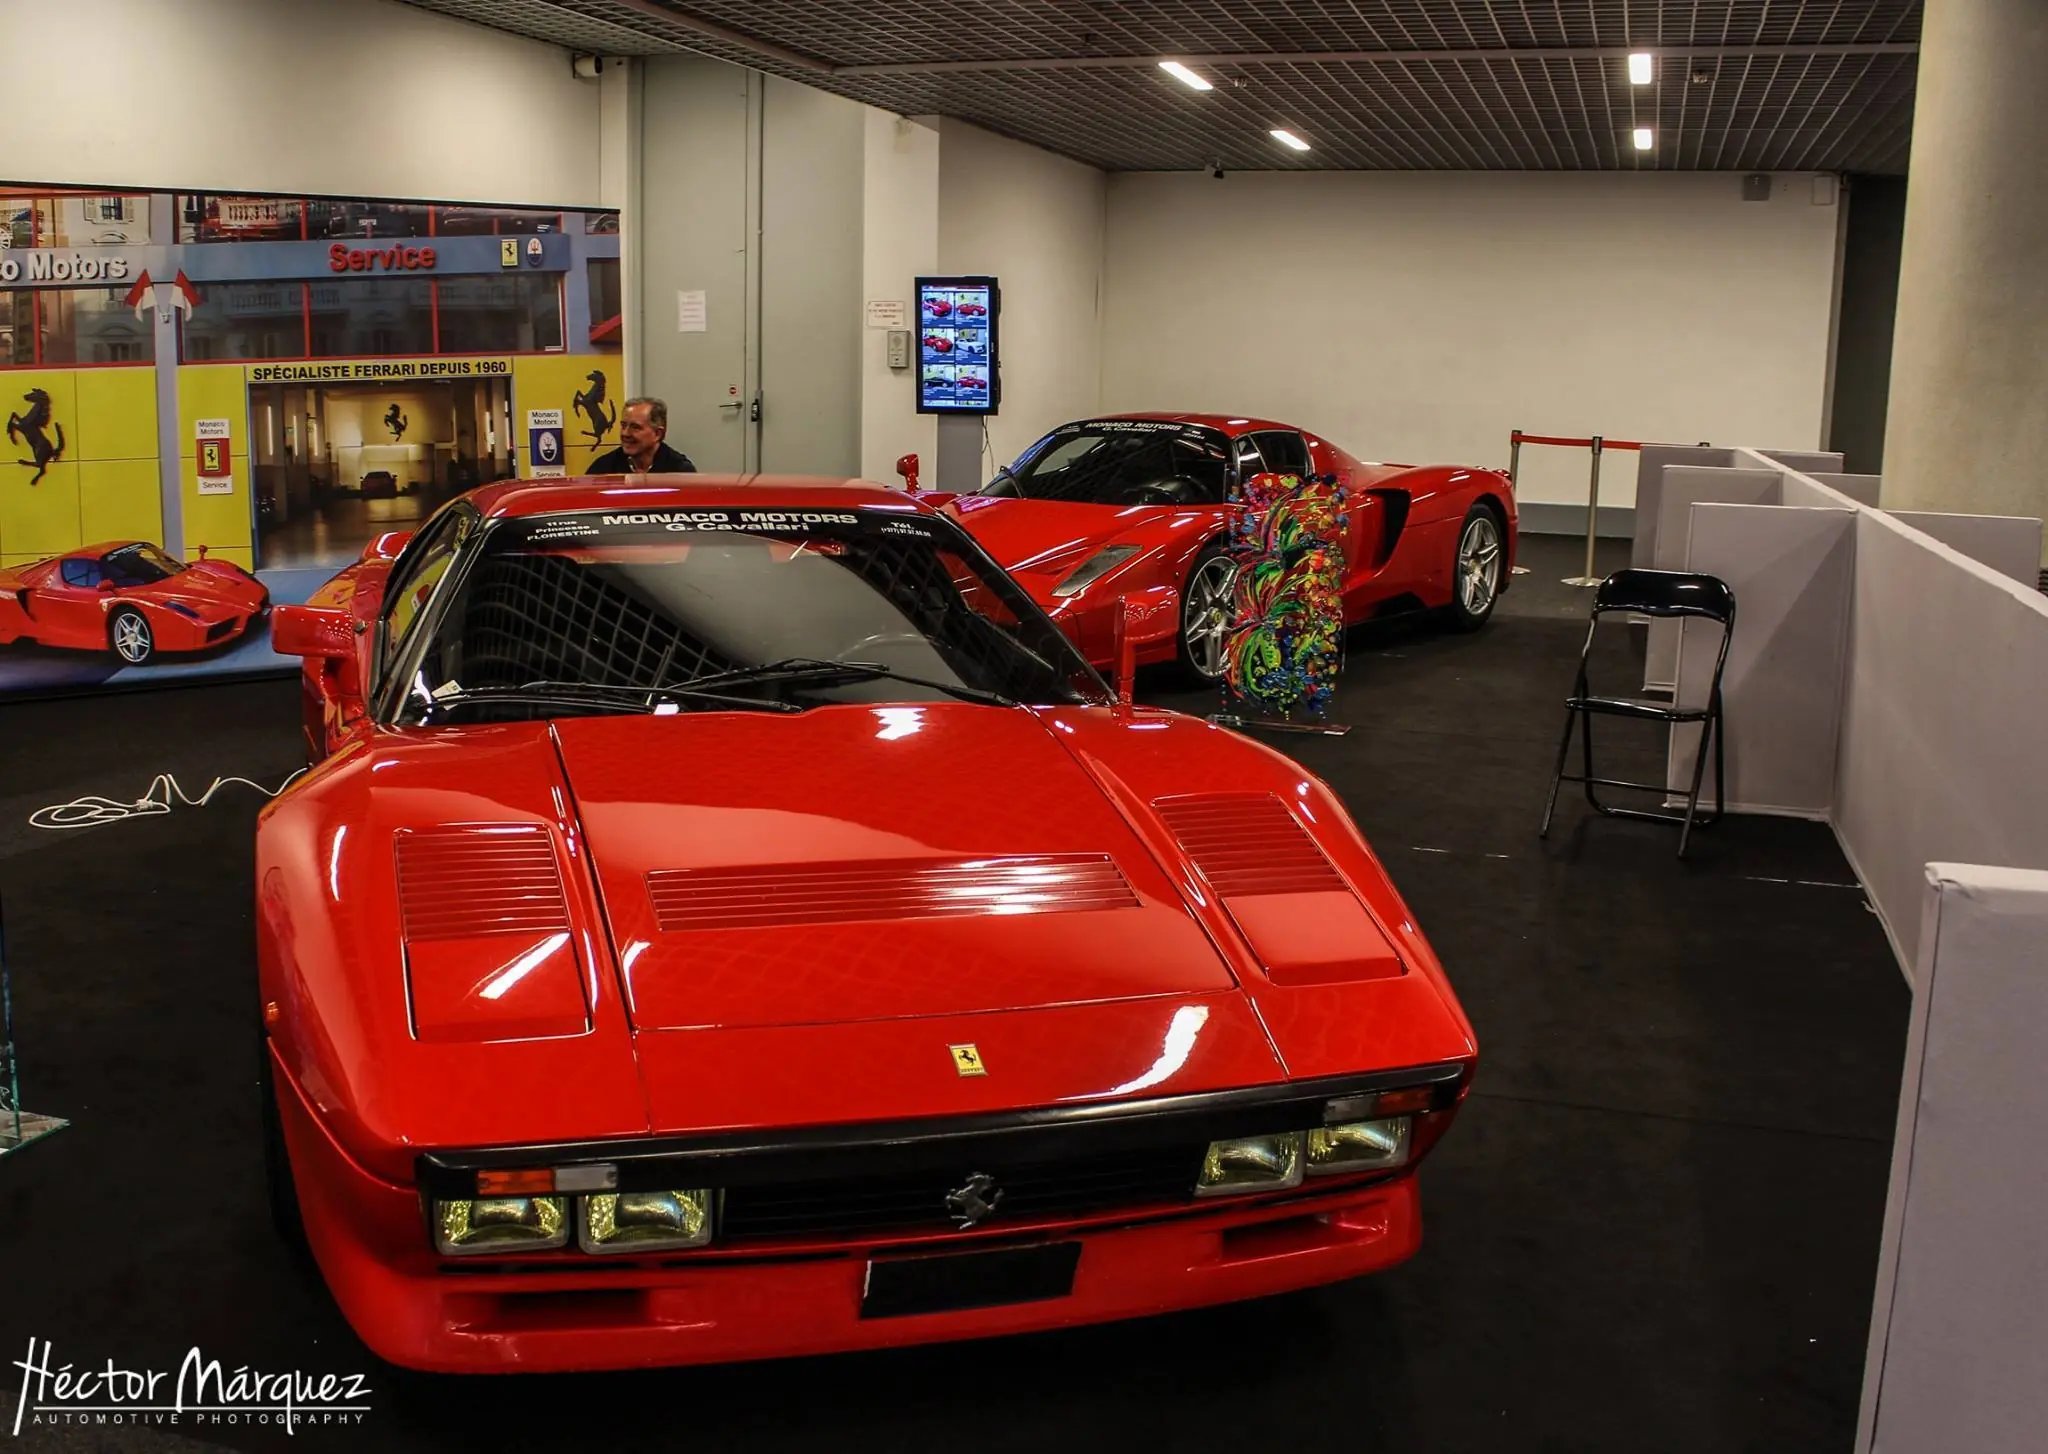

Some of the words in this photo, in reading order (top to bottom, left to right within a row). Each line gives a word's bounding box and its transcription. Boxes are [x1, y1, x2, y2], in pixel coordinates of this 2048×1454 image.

[328, 242, 437, 273] Service
[0, 259, 20, 281] o
[27, 251, 129, 281] Motors
[253, 364, 350, 380] SPÉCIALISTE
[354, 363, 416, 377] FERRARI
[420, 362, 471, 375] DEPUIS
[474, 361, 507, 373] 1960
[1085, 422, 1134, 430] MONACO
[1135, 422, 1182, 431] MOTORS
[203, 481, 227, 489] Service
[602, 513, 730, 525] MONACO
[741, 512, 858, 524] MOTORS
[665, 523, 694, 532] G.
[698, 522, 809, 532] Cavallari
[527, 529, 599, 541] FLORESTINE
